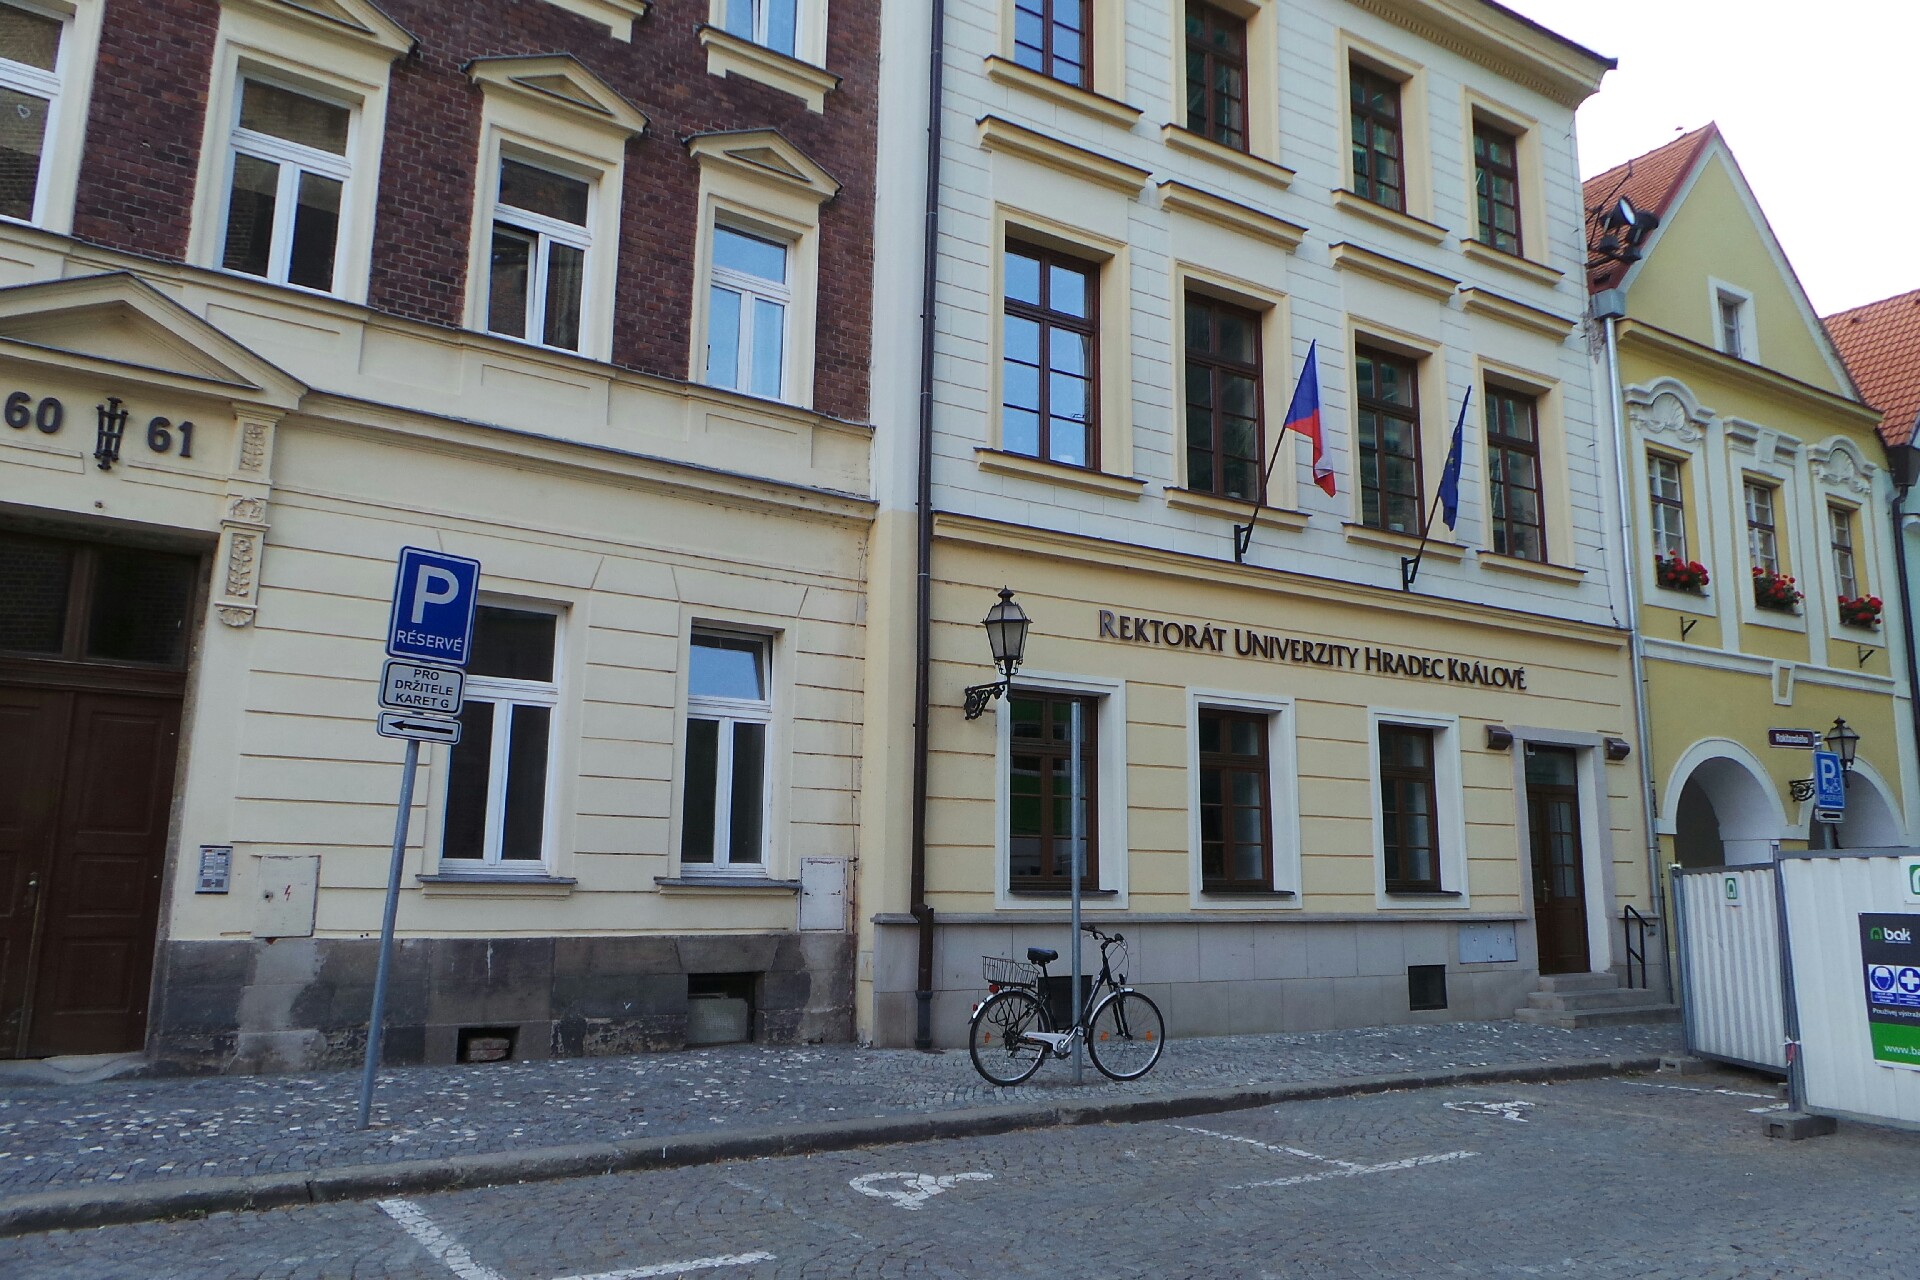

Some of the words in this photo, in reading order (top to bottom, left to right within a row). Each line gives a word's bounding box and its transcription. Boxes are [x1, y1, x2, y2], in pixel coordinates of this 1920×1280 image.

[5, 391, 63, 433] 60
[147, 416, 194, 458] 61
[411, 564, 460, 624] P
[396, 629, 463, 652] RÉSERVÉ
[1099, 609, 1227, 652] REKTORÁT
[1234, 628, 1359, 669] UNIVERZITY
[1365, 646, 1445, 680] HRADEC
[1448, 657, 1528, 690] KRÁLOVÉ
[394, 679, 454, 697] DRŽITELE
[413, 668, 440, 682] PRO
[395, 692, 437, 707] KARET
[440, 698, 450, 709] G
[1820, 759, 1836, 790] P
[1883, 927, 1911, 941] bak
